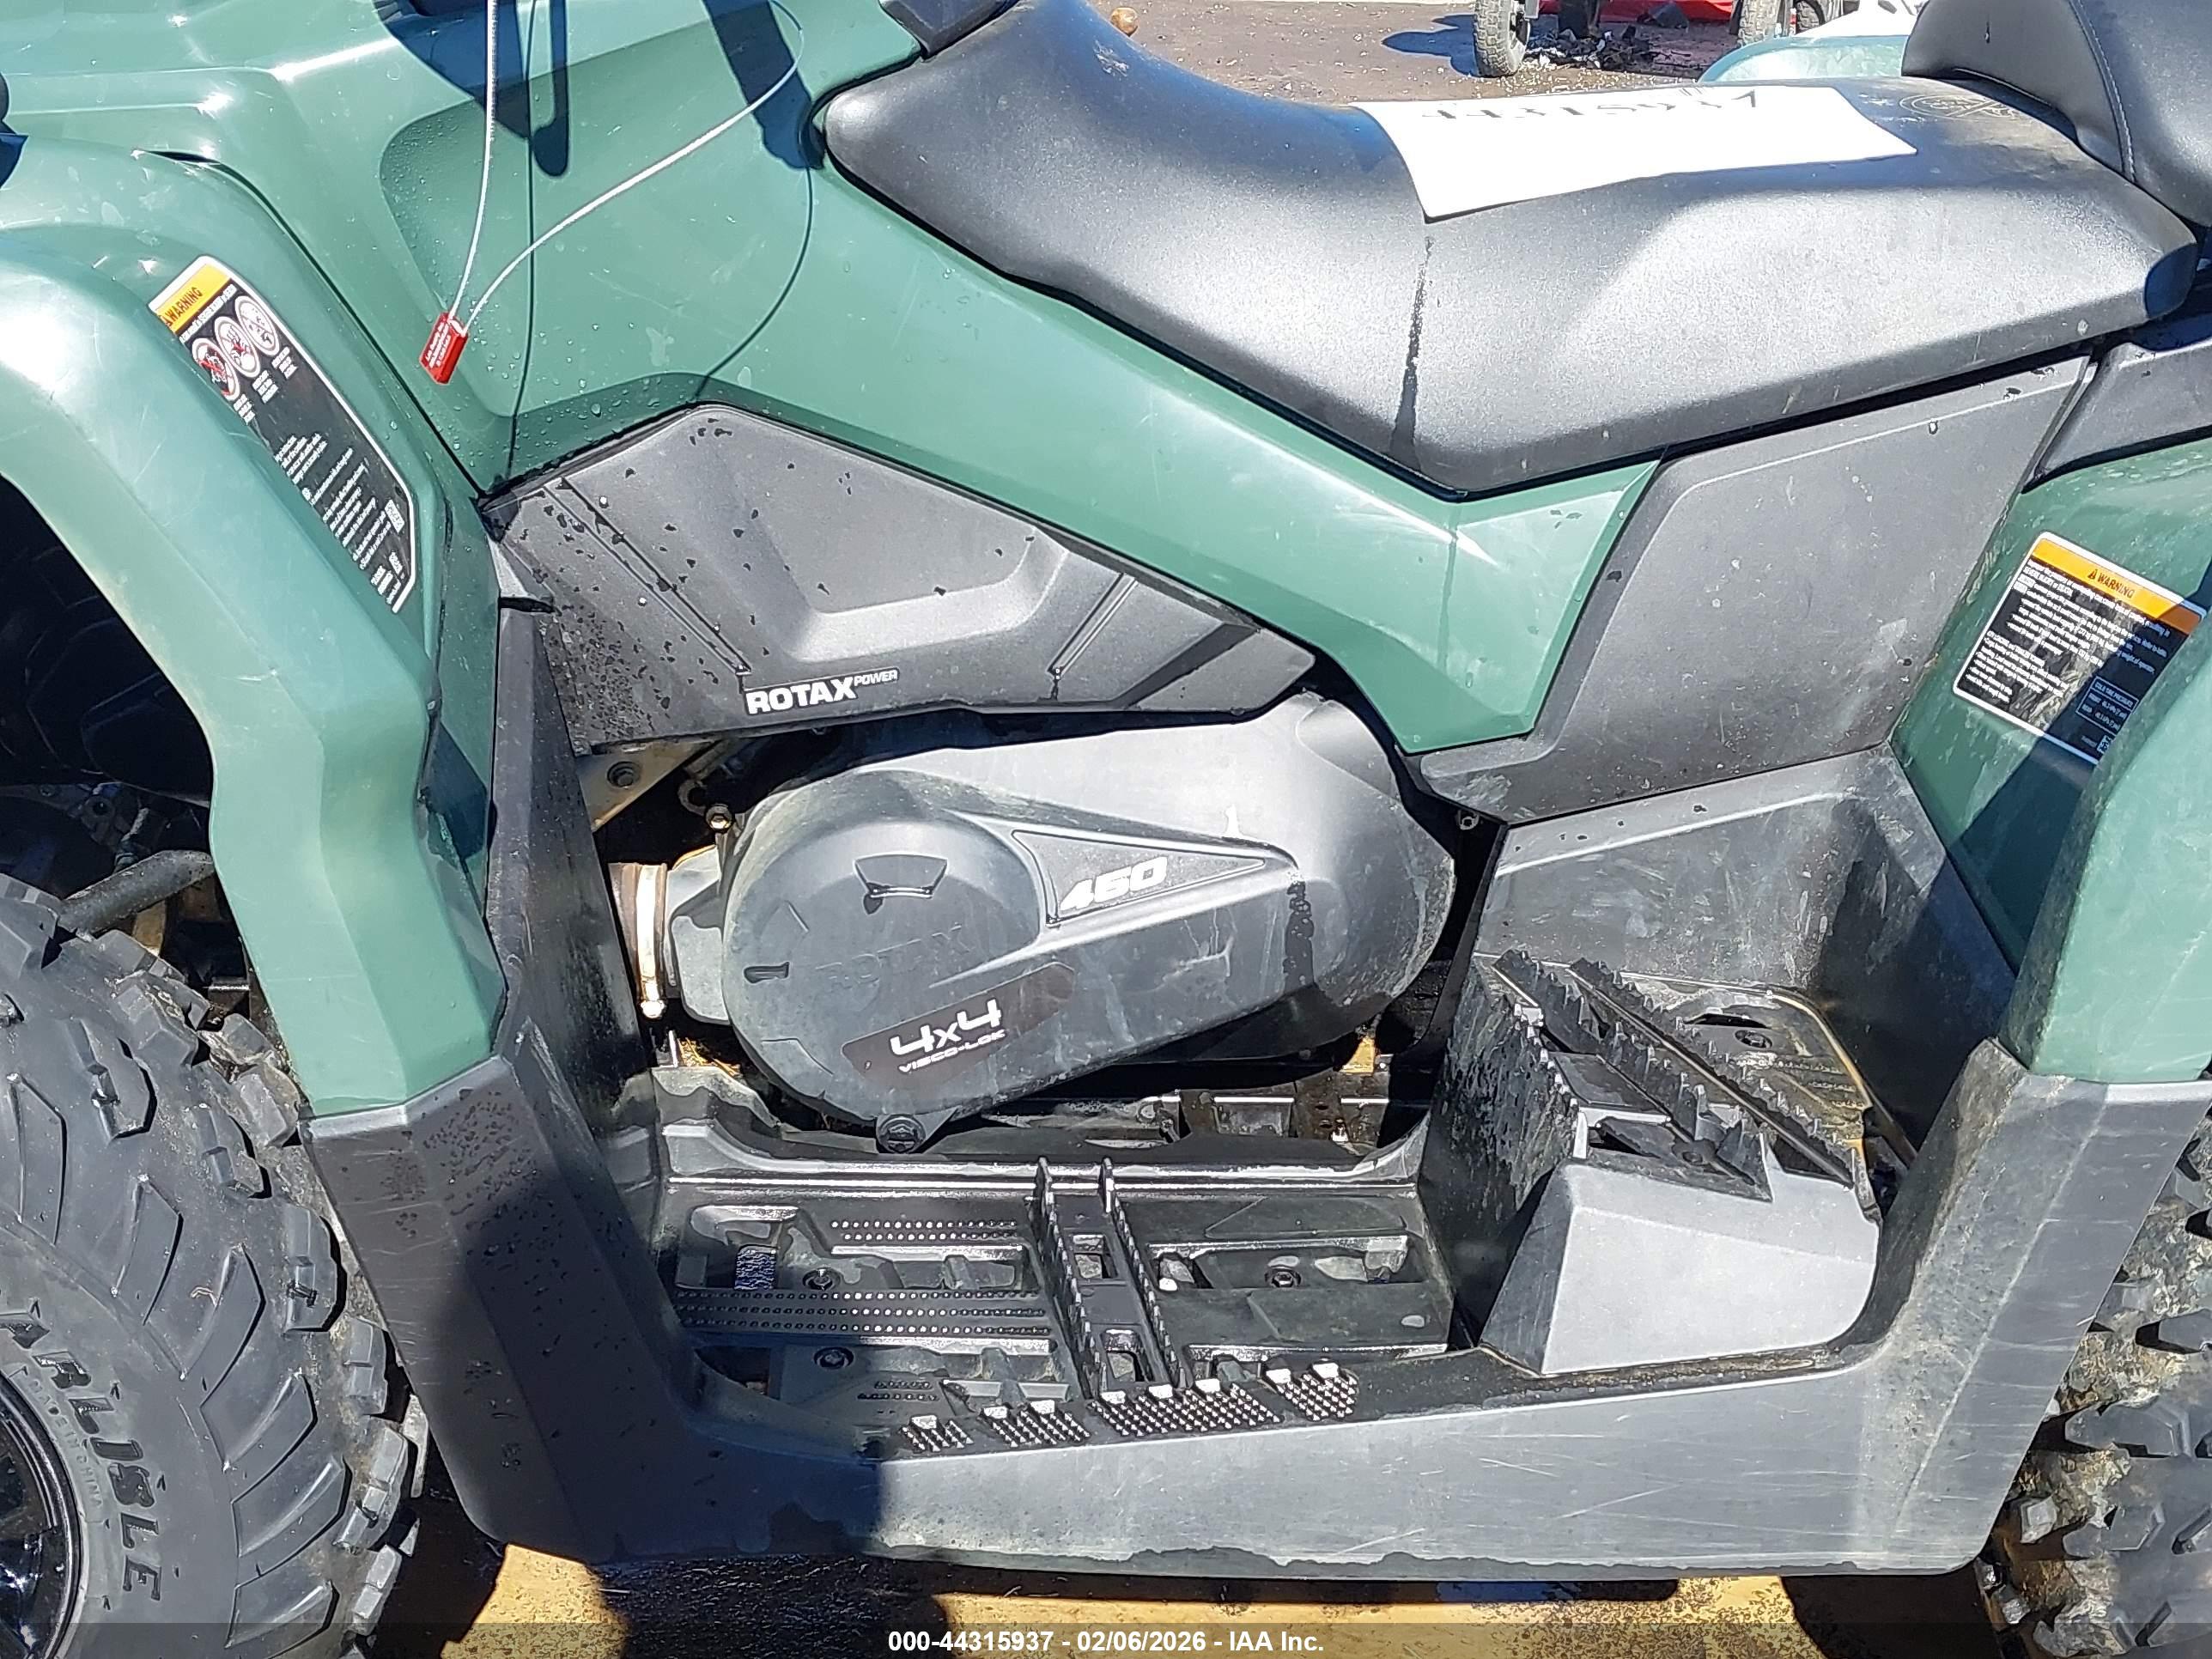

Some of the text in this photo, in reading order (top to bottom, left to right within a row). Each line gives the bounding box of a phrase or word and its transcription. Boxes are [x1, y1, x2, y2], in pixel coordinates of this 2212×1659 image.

[165, 286, 204, 323] WARNING
[2097, 573, 2136, 599] WARNING
[745, 669, 898, 714] ROTAX POWER
[890, 999, 1002, 1055] 4x4
[898, 1029, 1006, 1073] VISCO-LOK
